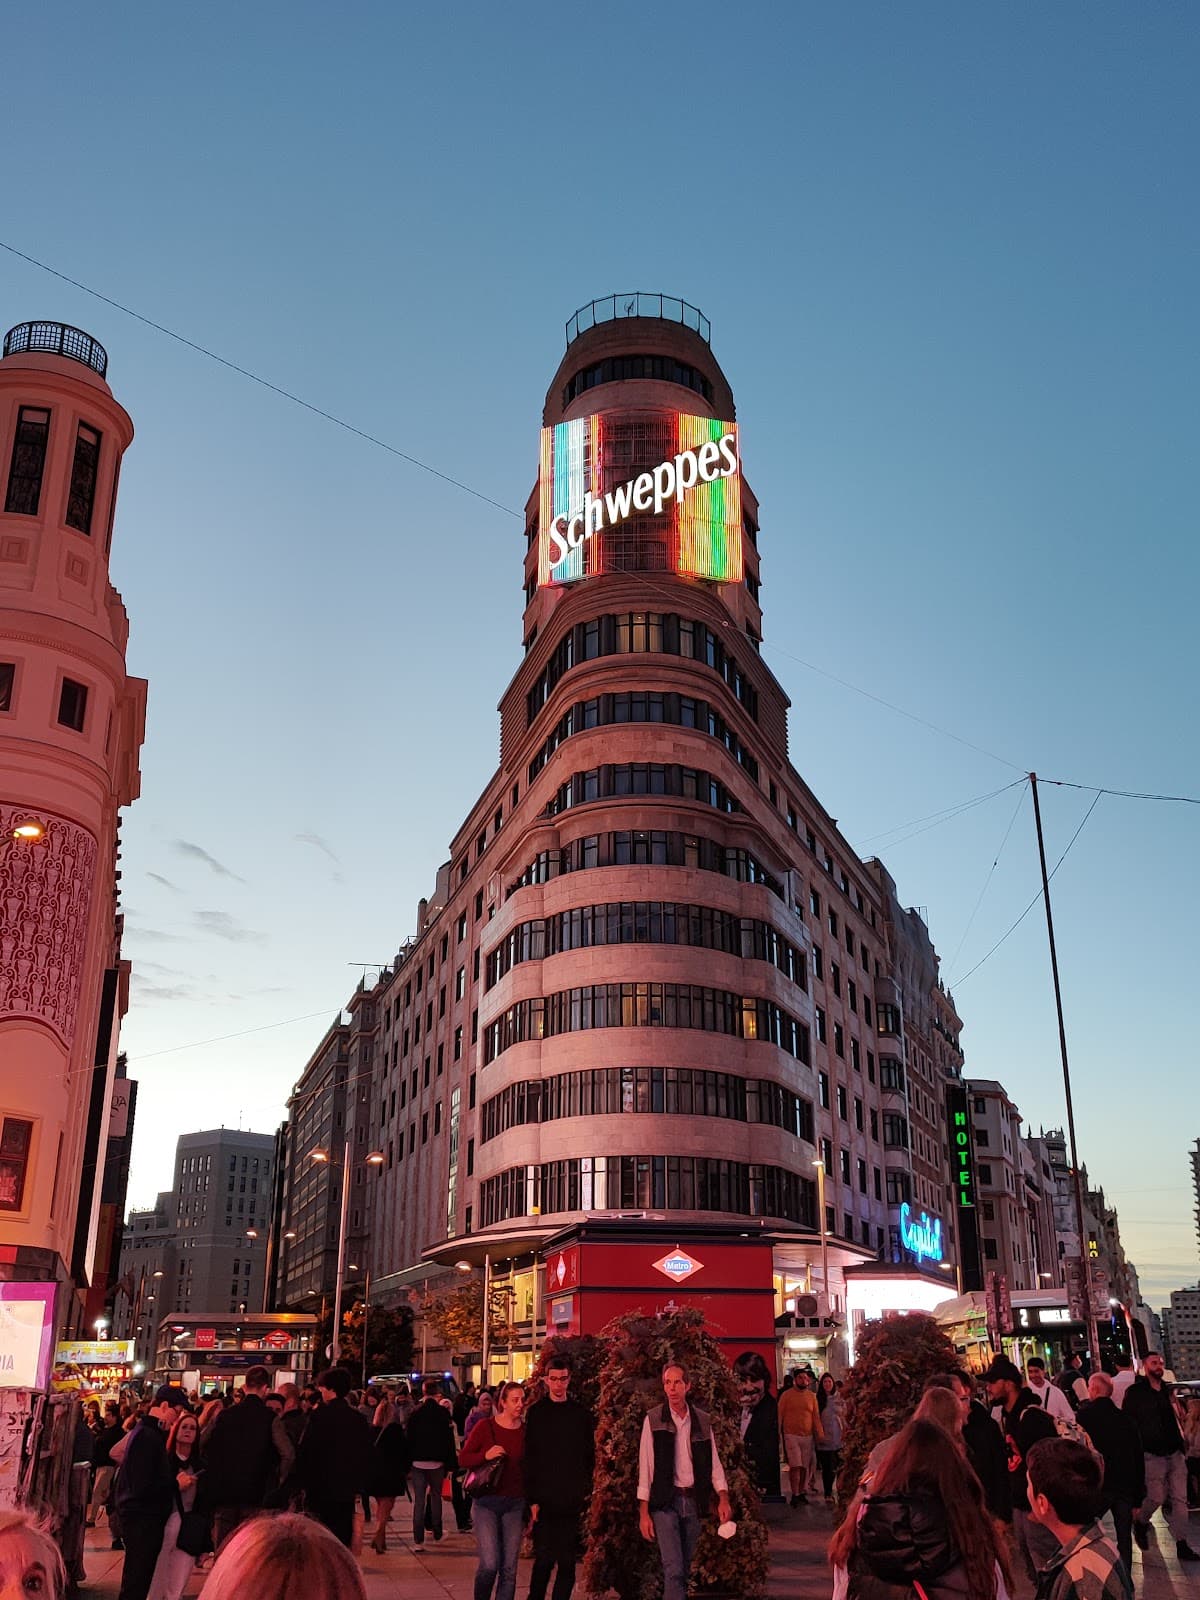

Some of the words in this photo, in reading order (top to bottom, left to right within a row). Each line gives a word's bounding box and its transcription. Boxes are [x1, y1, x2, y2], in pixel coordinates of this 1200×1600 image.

[550, 434, 737, 569] Schweppes
[955, 1112, 971, 1206] HOTEL
[667, 1261, 689, 1271] Metro
[1019, 1308, 1029, 1328] 2
